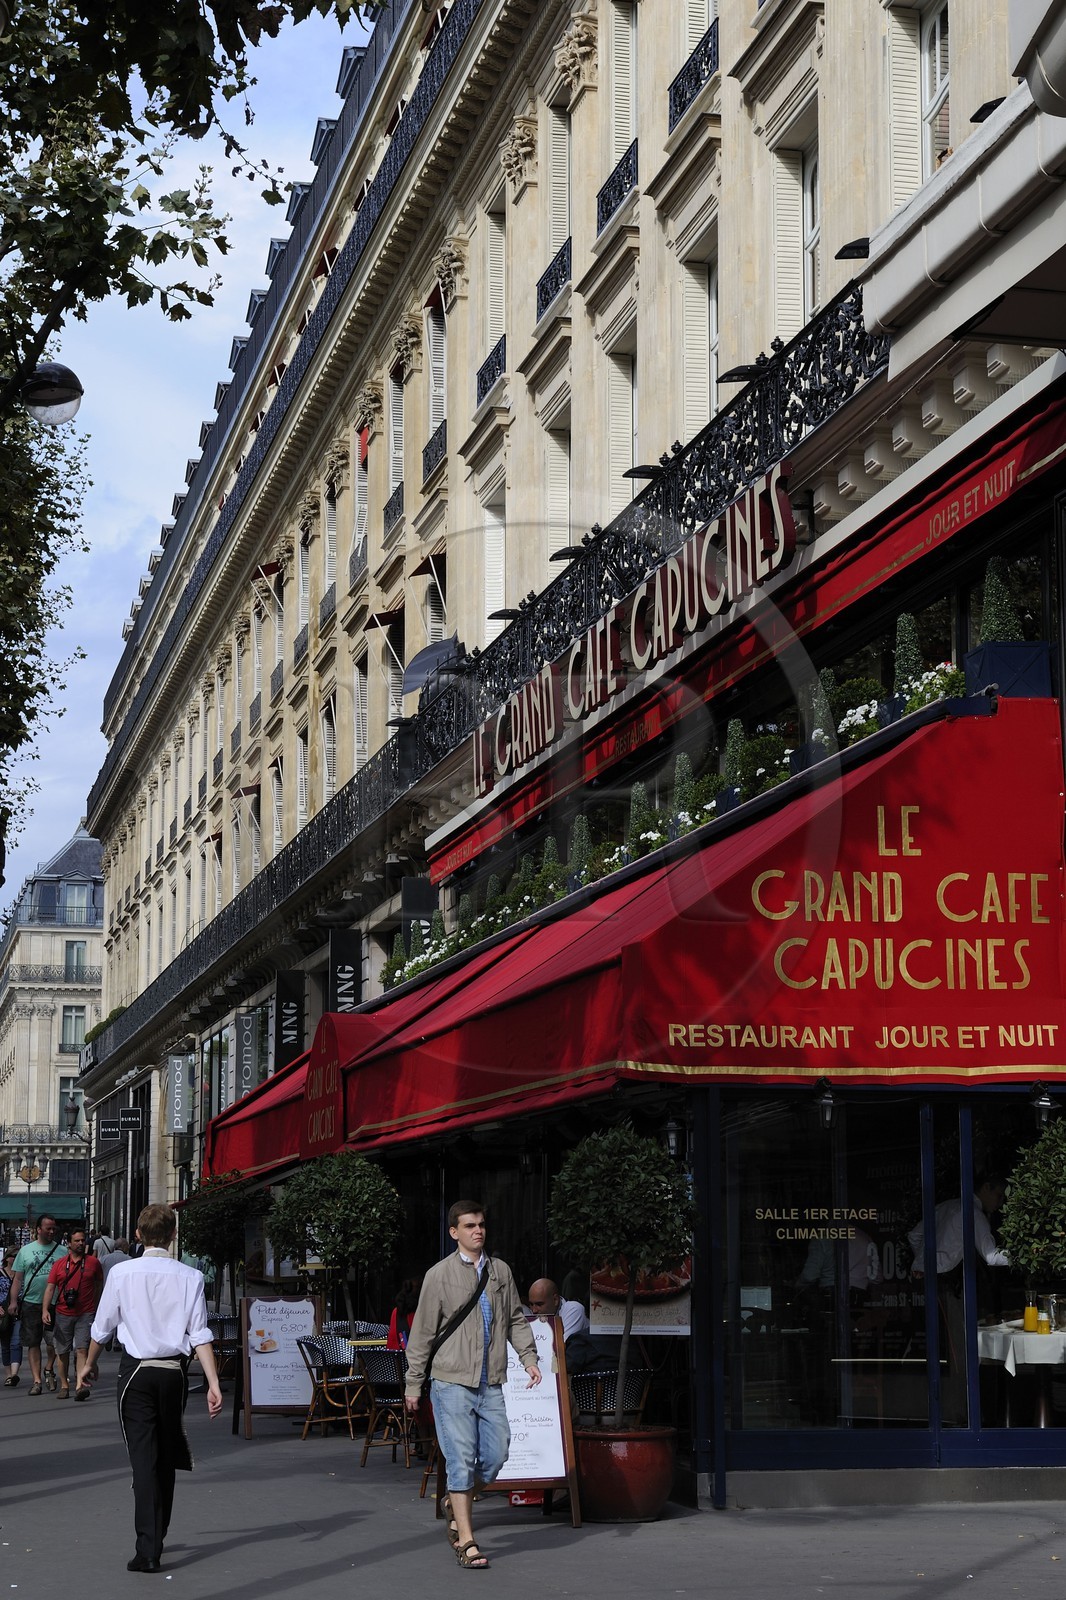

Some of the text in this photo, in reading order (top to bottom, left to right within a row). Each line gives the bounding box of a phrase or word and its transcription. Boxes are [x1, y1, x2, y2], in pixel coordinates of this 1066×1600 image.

[925, 459, 1016, 545] JOUR ET NUIT
[473, 463, 795, 798] LE GRAND CAFE CAPUCINES
[877, 805, 922, 856] LE
[751, 869, 1050, 924] GRAND CAFE
[773, 937, 1031, 990] CAPUCINES
[282, 1000, 298, 1045] MNG
[668, 1023, 1059, 1049] RESTAURANT JOUR ET NUIT
[173, 1059, 183, 1130] promod
[755, 1208, 800, 1221] SALLE
[803, 1208, 829, 1221] 1ER
[833, 1208, 878, 1221] ETAGE
[776, 1227, 856, 1240] CLIMATISEE
[255, 1304, 311, 1319] Petit déjeuner
[261, 1315, 283, 1324] Express
[521, 1413, 553, 1422] Parisien
